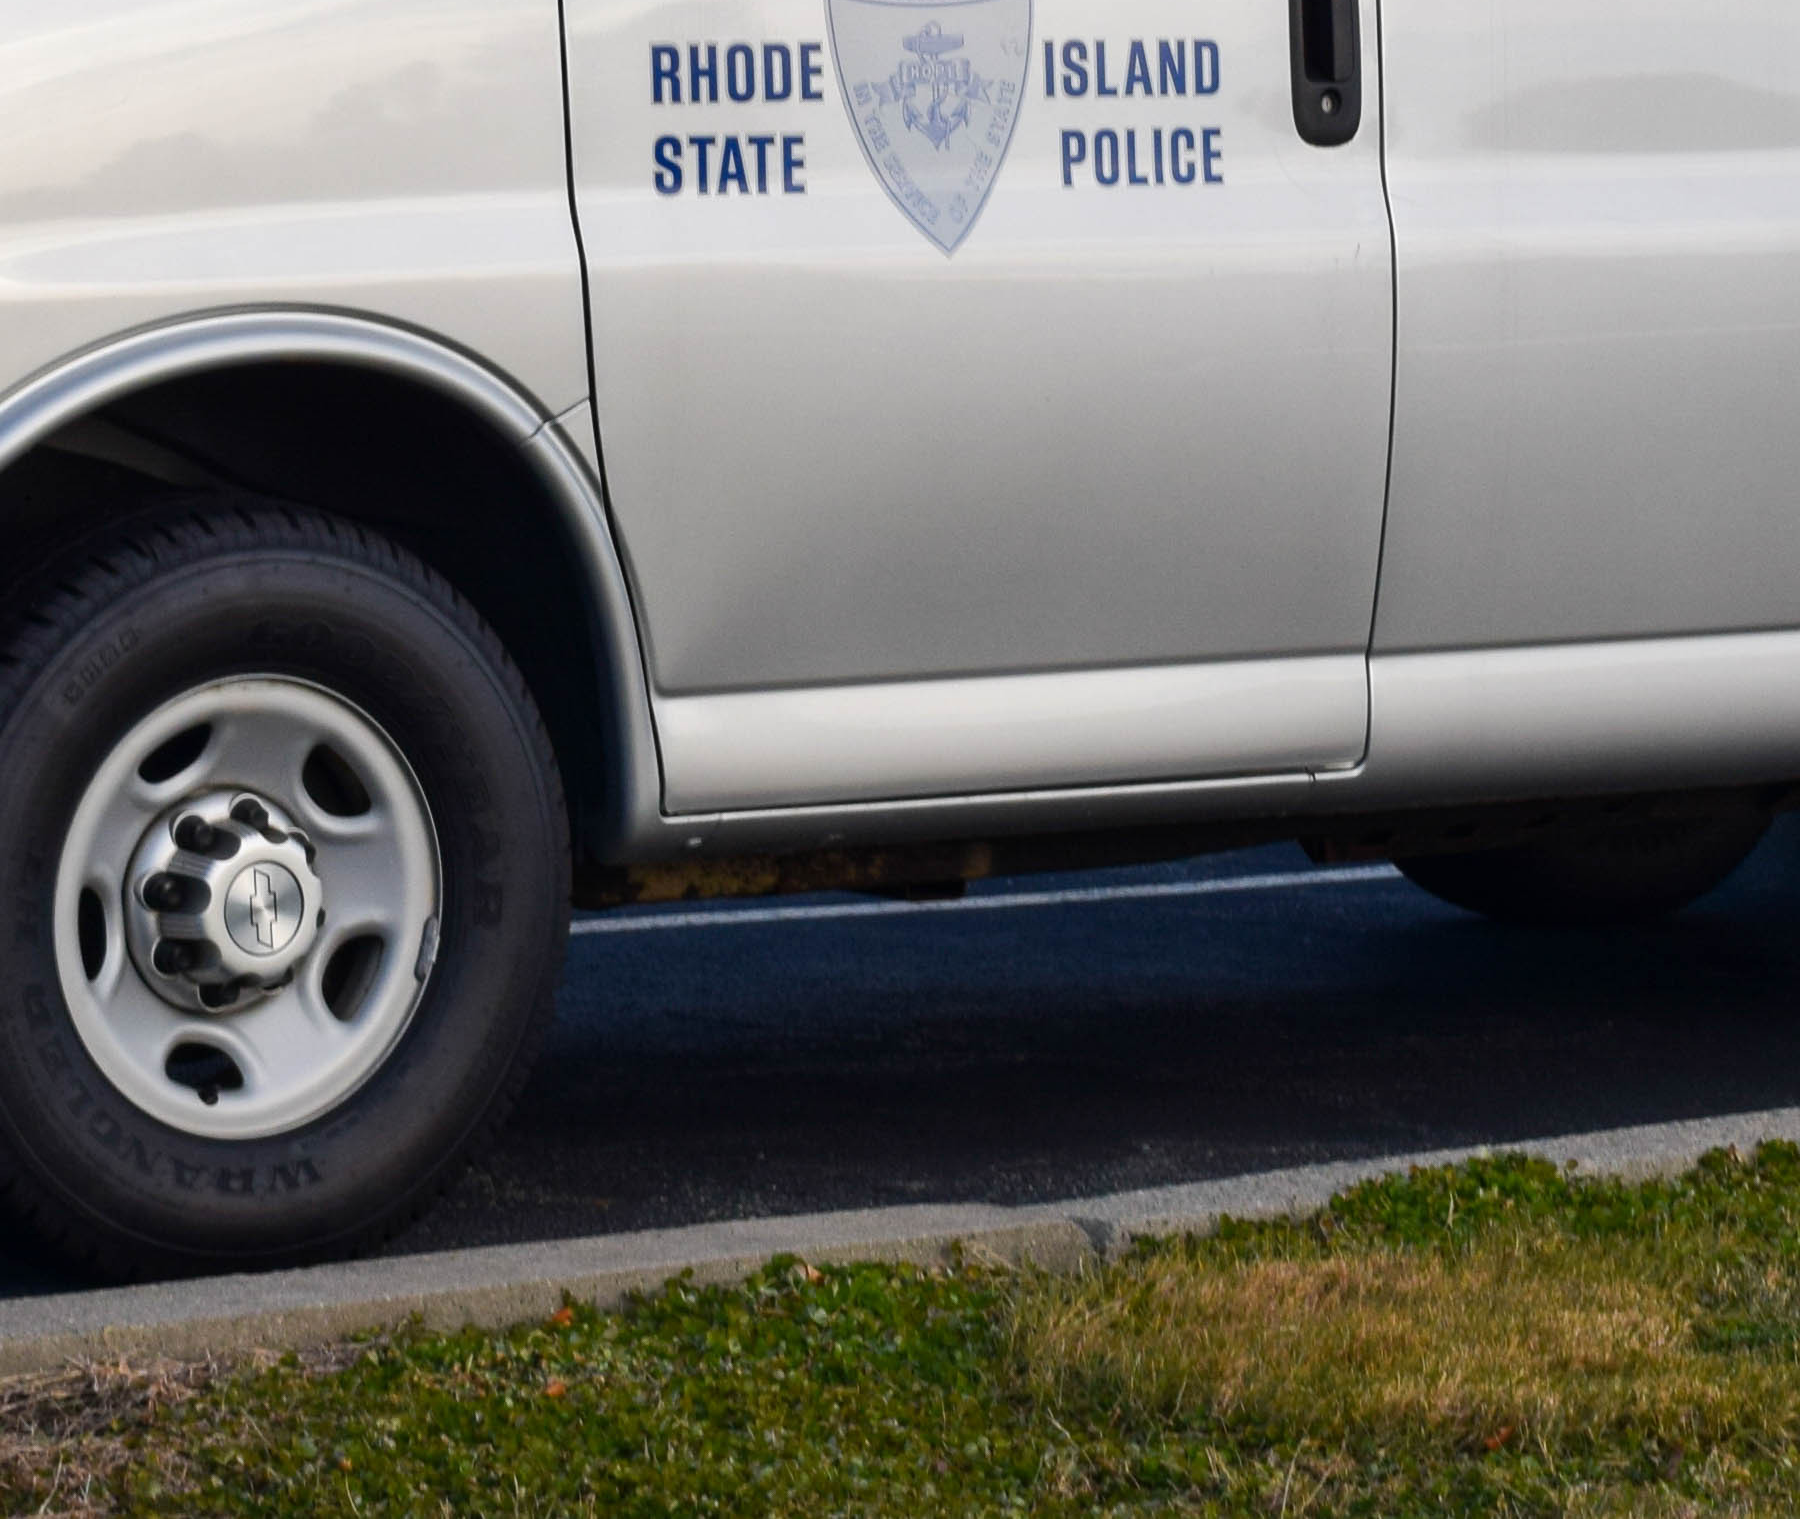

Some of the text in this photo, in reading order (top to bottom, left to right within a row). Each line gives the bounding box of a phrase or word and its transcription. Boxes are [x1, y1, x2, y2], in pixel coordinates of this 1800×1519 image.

[651, 39, 1221, 104] RHODE ISLAND
[654, 127, 1223, 195] STATE POLICE
